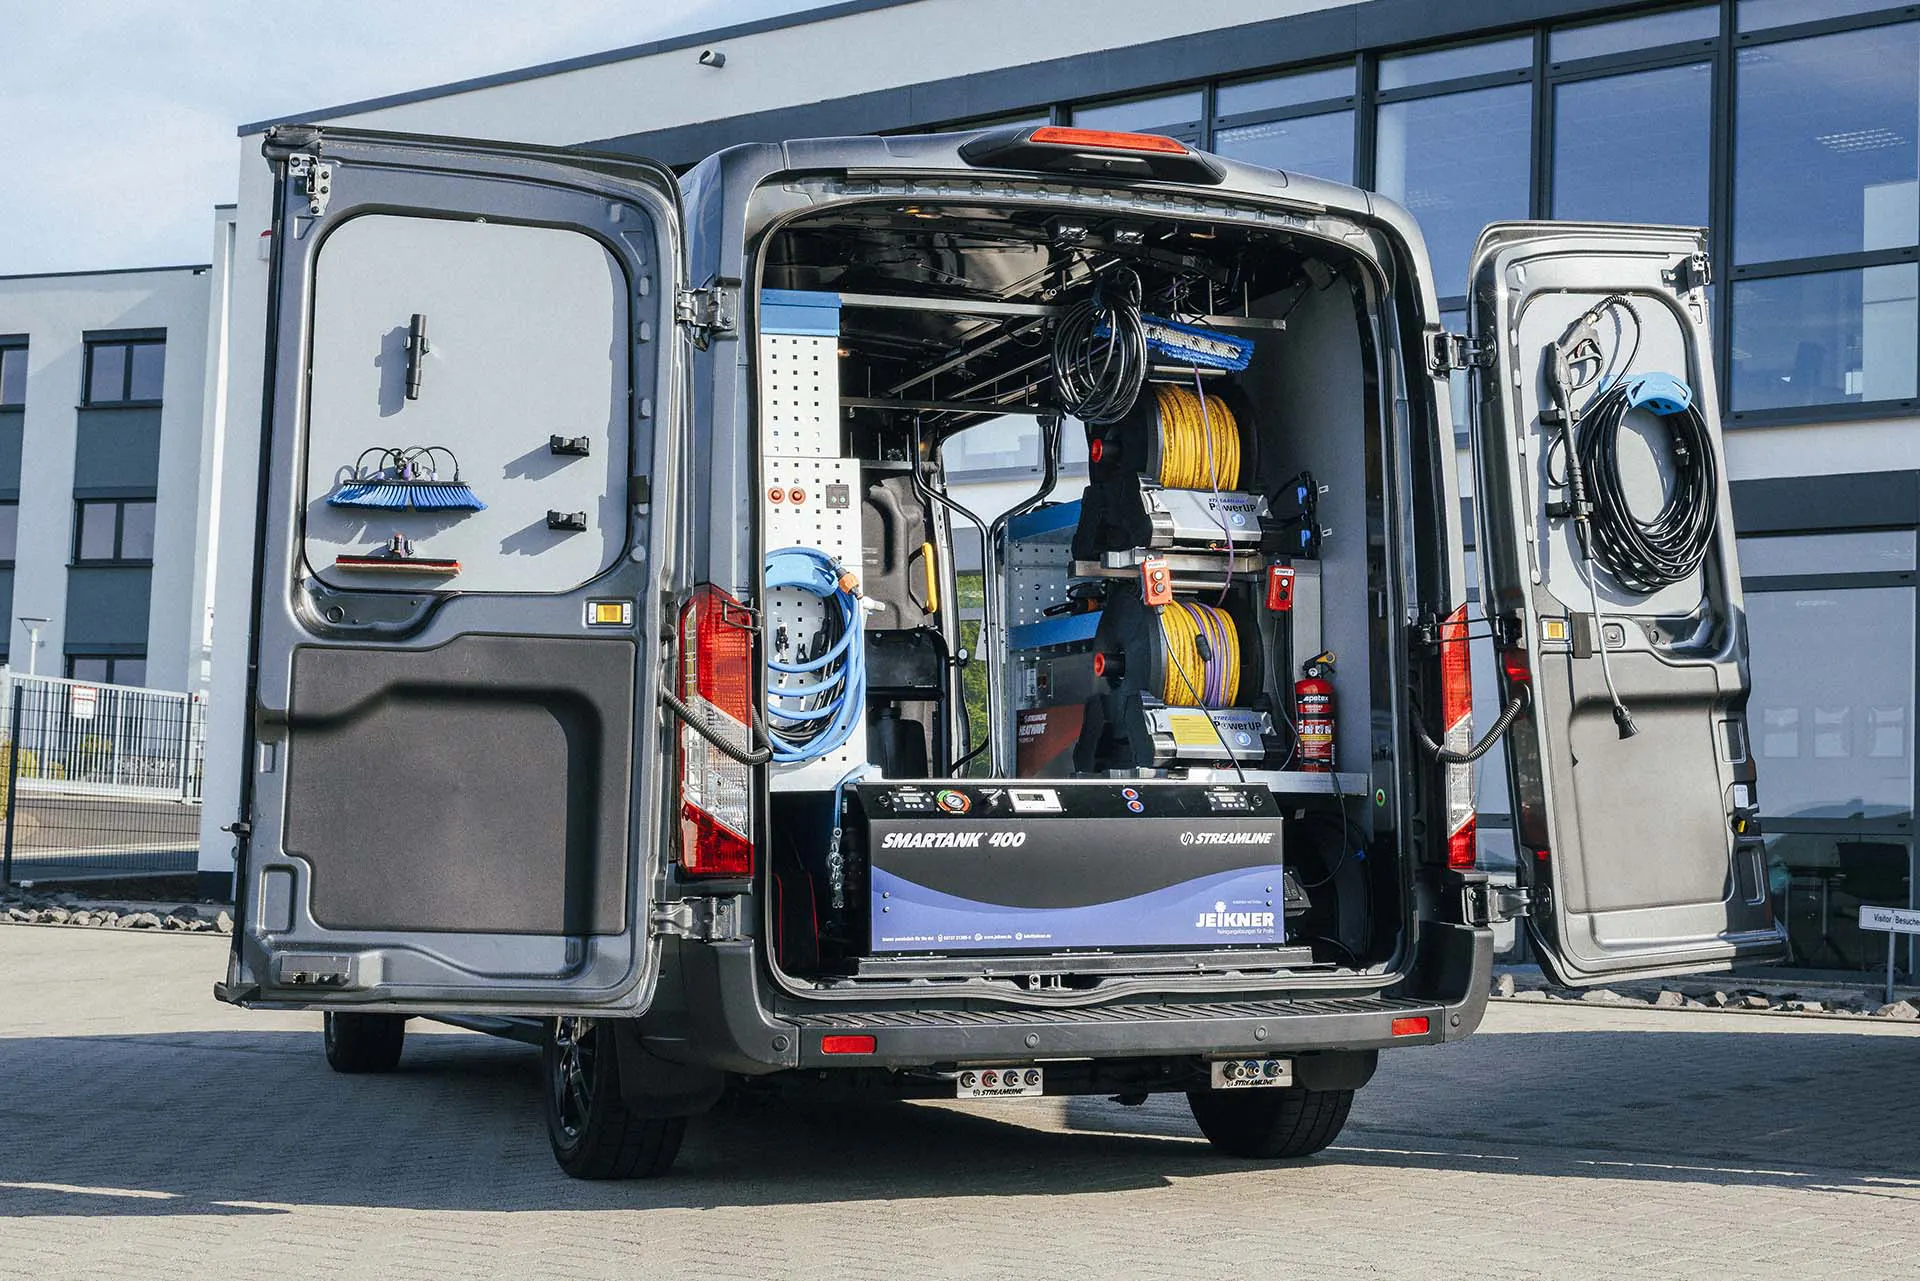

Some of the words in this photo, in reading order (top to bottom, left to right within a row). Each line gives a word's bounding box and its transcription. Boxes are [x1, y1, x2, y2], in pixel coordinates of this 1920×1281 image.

[881, 831, 985, 849] SMARTANK
[988, 831, 1027, 848] 400
[1195, 832, 1273, 845] STREAMLINE
[1195, 901, 1275, 928] JEIKNER
